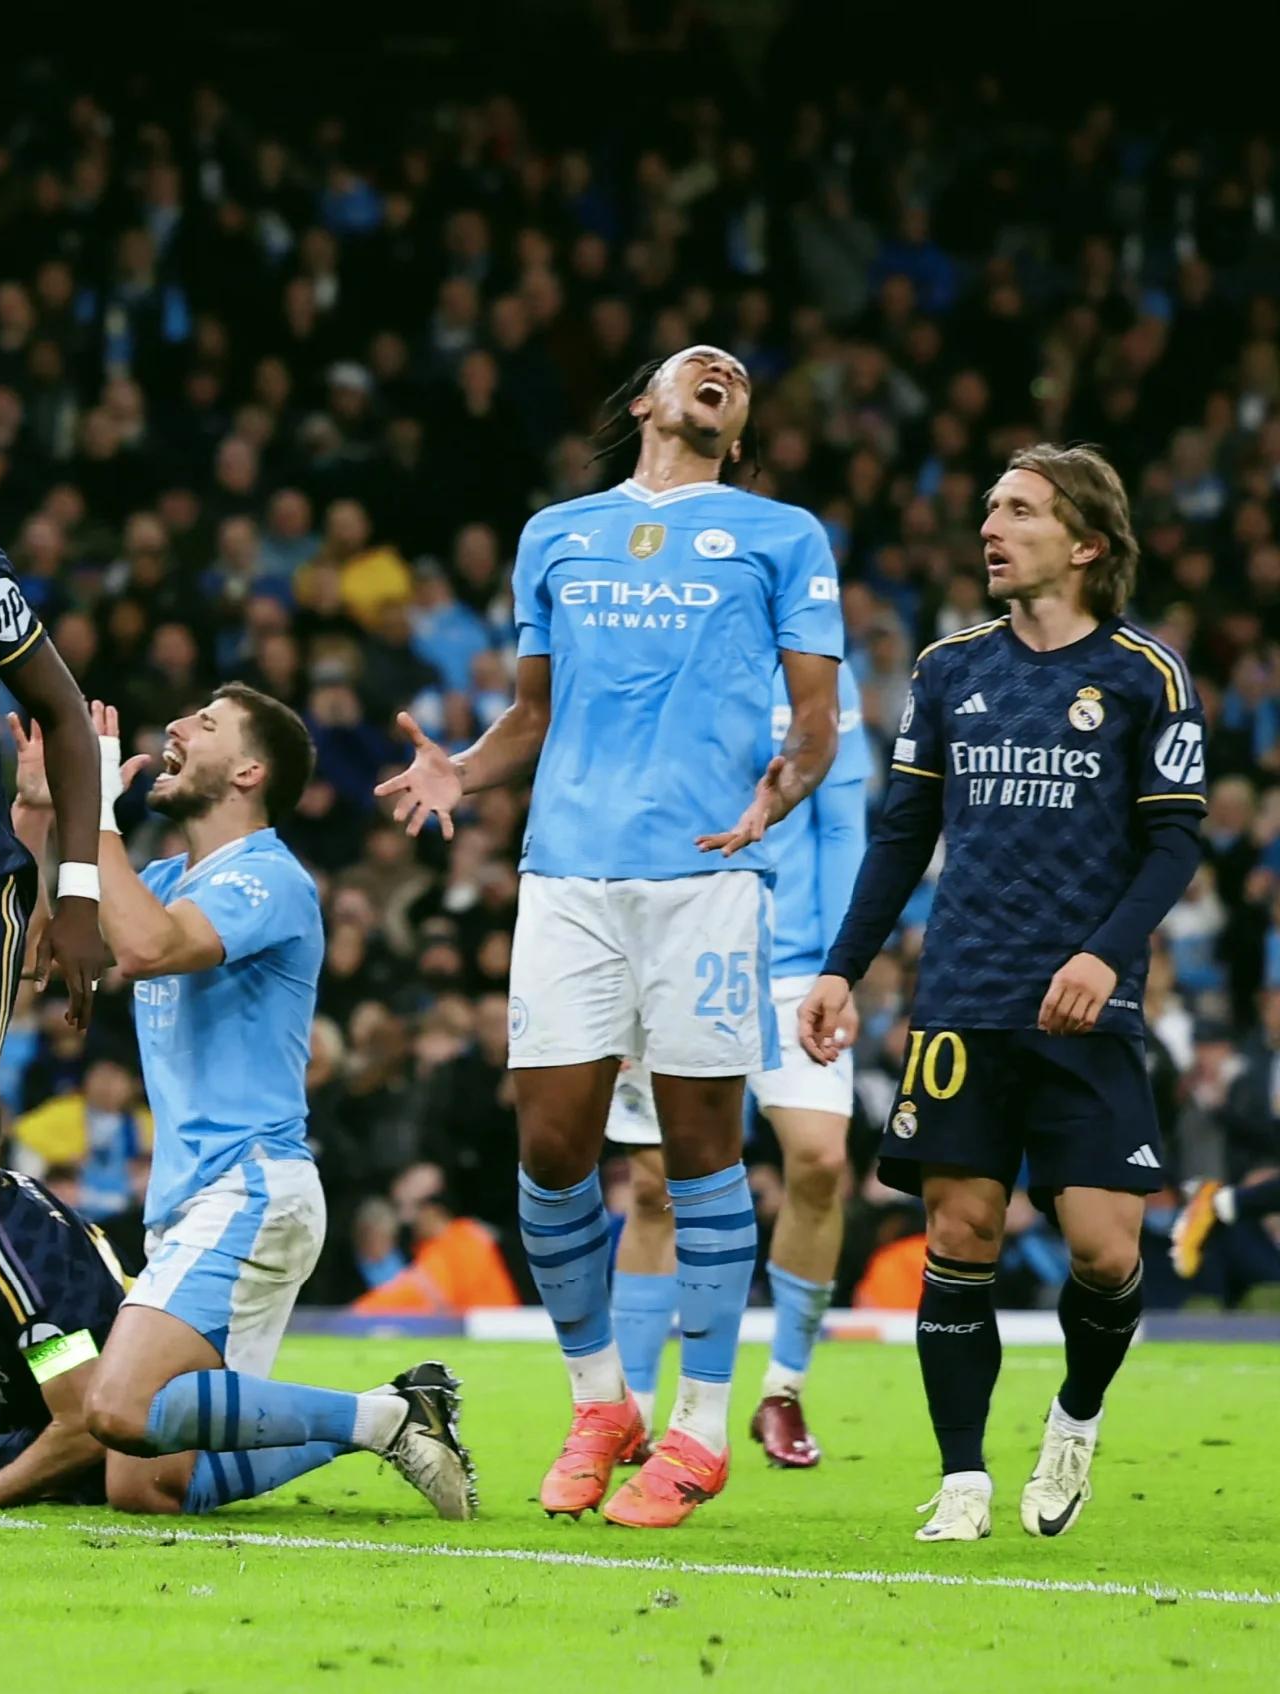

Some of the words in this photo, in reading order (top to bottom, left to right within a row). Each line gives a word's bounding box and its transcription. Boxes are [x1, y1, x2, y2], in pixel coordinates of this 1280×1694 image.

[560, 580, 719, 606] ETIHAD
[582, 611, 688, 629] AIRWAYS
[950, 738, 1101, 779] Emirates
[969, 778, 995, 806] FLY
[1000, 779, 1076, 809] BETTER
[694, 951, 751, 1017] 25
[901, 1030, 967, 1100] 10
[918, 1320, 985, 1333] RMCF
